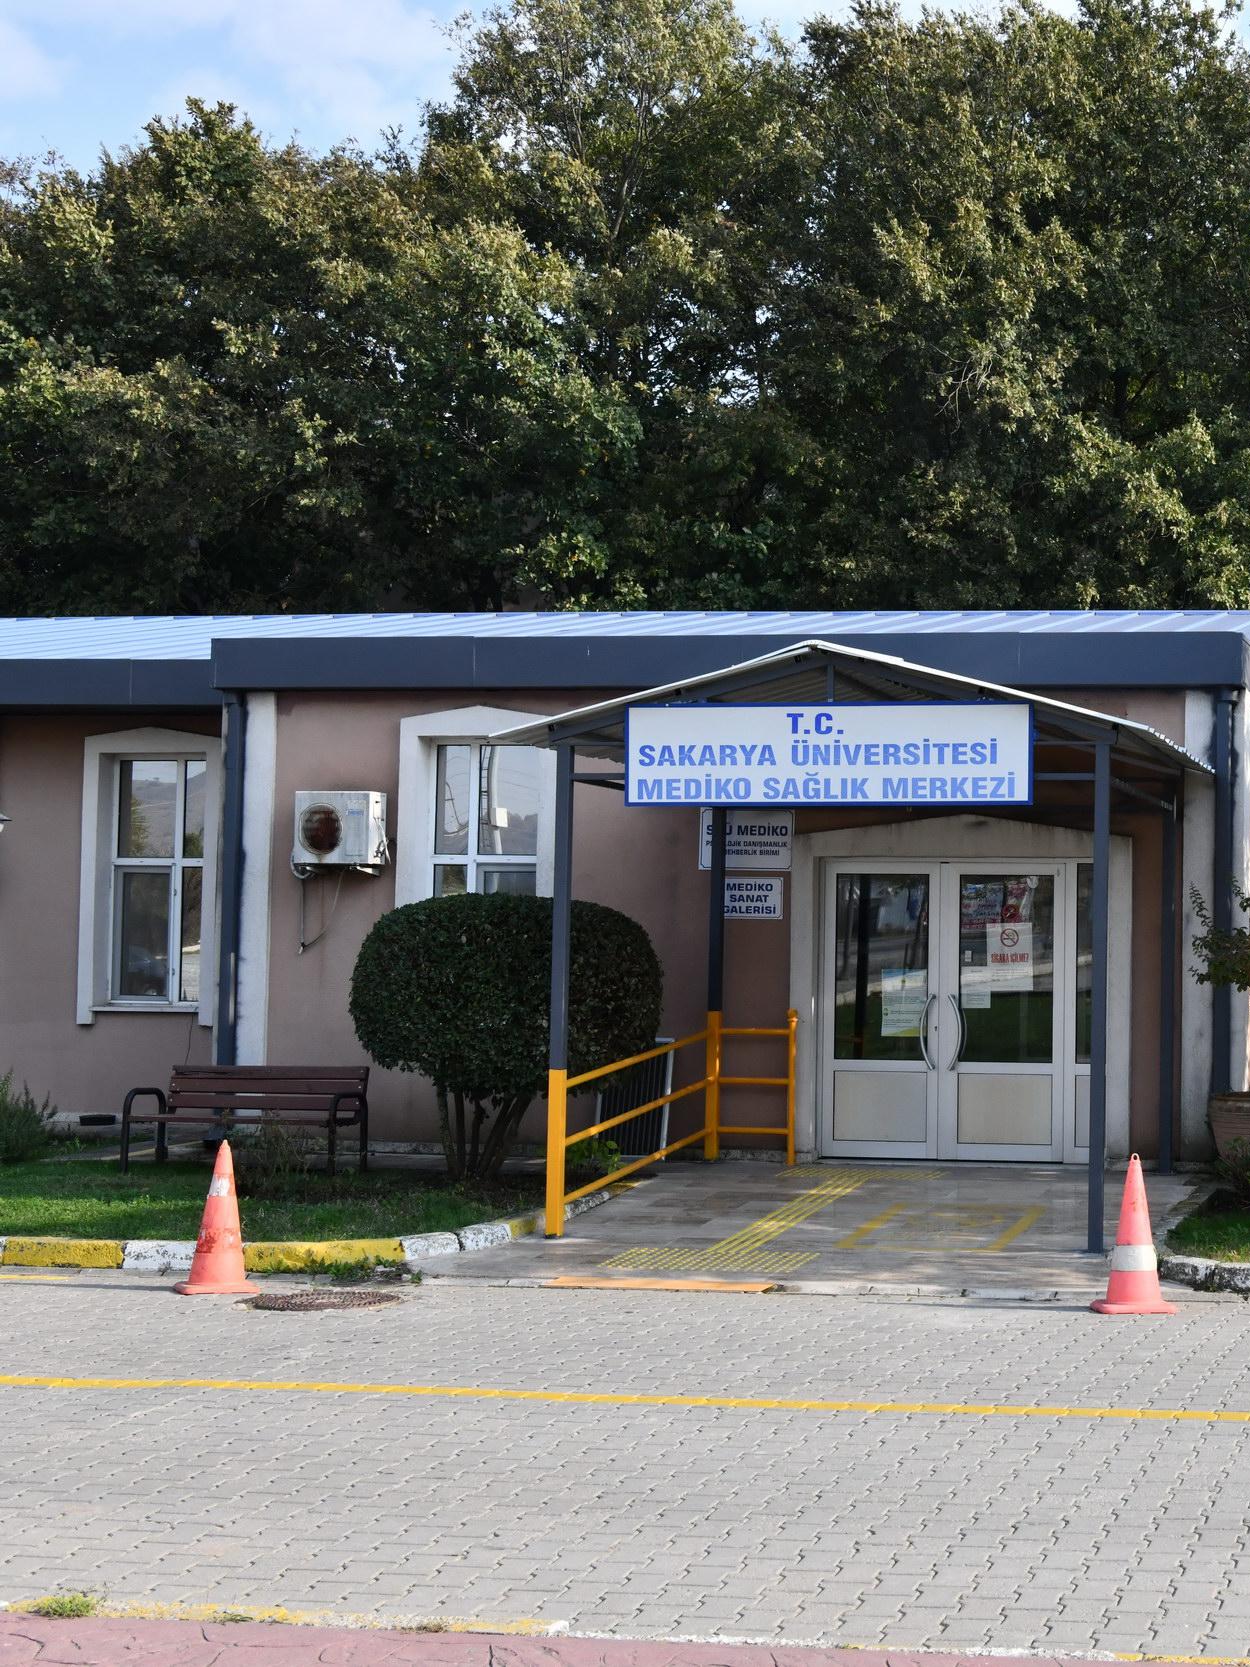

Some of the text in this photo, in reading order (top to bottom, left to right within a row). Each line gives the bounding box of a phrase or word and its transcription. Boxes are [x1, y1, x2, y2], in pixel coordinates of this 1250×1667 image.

[786, 712, 844, 735] T.C.
[638, 738, 998, 767] SAKARYA ÜNİVERSİTESİ
[637, 771, 1016, 800] MEDİKO SAĞLIK MERKEZİ
[706, 822, 788, 837] SÜ MEDİKO
[725, 848, 758, 856] EHBERLİK
[726, 881, 774, 892] MEDİKO
[729, 894, 770, 903] SANAT
[722, 904, 777, 915] GALERİSİ
